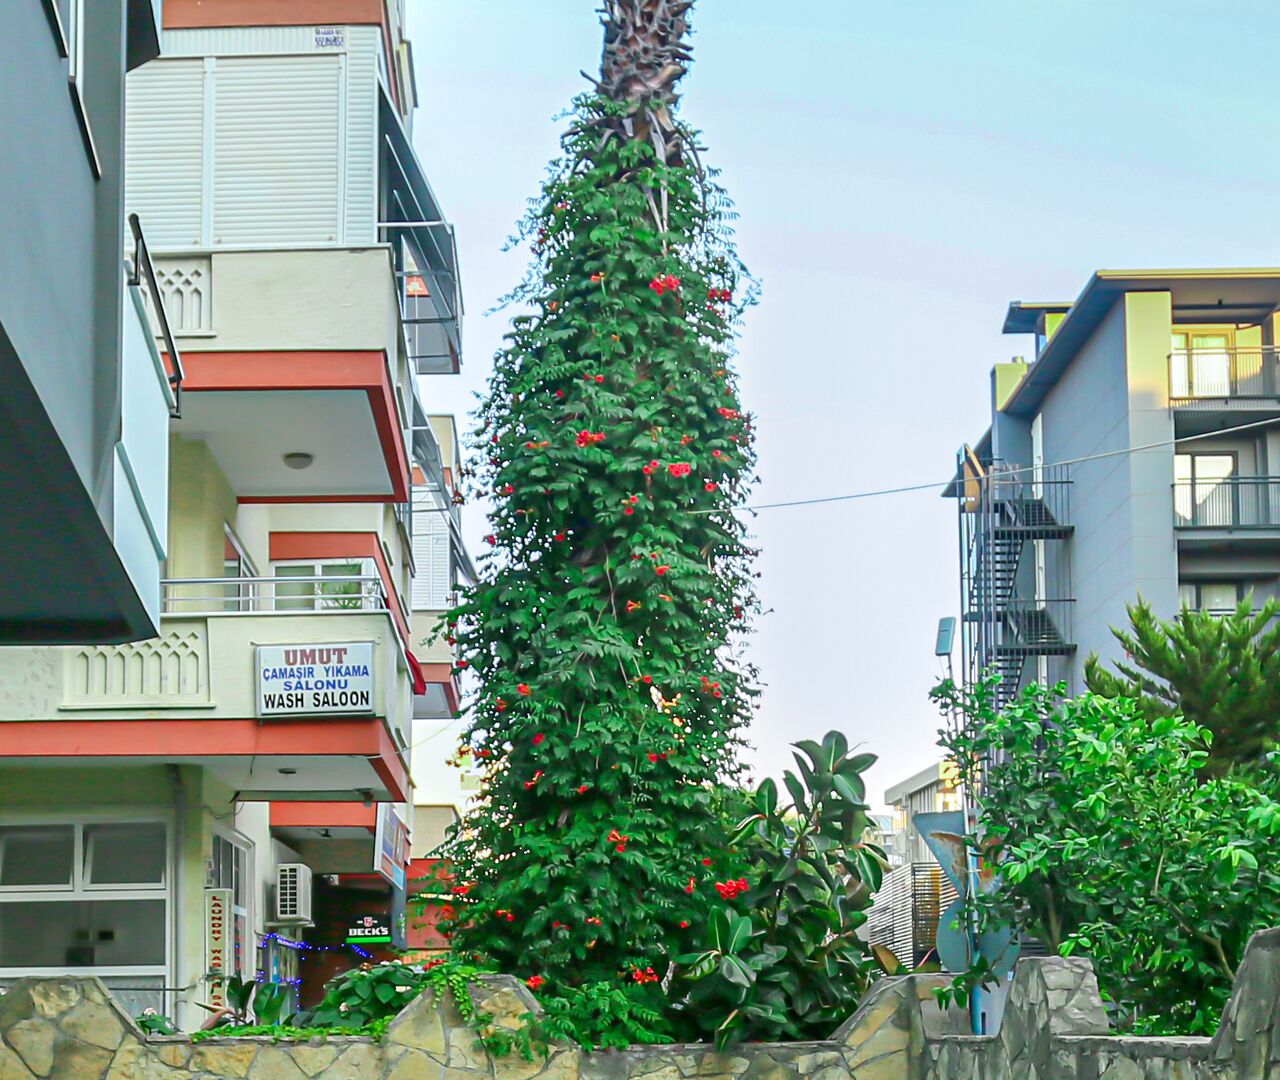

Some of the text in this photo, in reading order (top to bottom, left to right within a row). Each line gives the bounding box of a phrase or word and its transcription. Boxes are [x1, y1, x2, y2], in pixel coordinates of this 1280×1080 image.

[284, 648, 347, 665] UMUT
[263, 665, 369, 681] ÇAMAŞIR YIKAMA
[283, 679, 348, 691] SALONU
[264, 690, 369, 709] WASH SALOON
[211, 896, 222, 941] LAUNDRY
[348, 926, 389, 936] BECK'S
